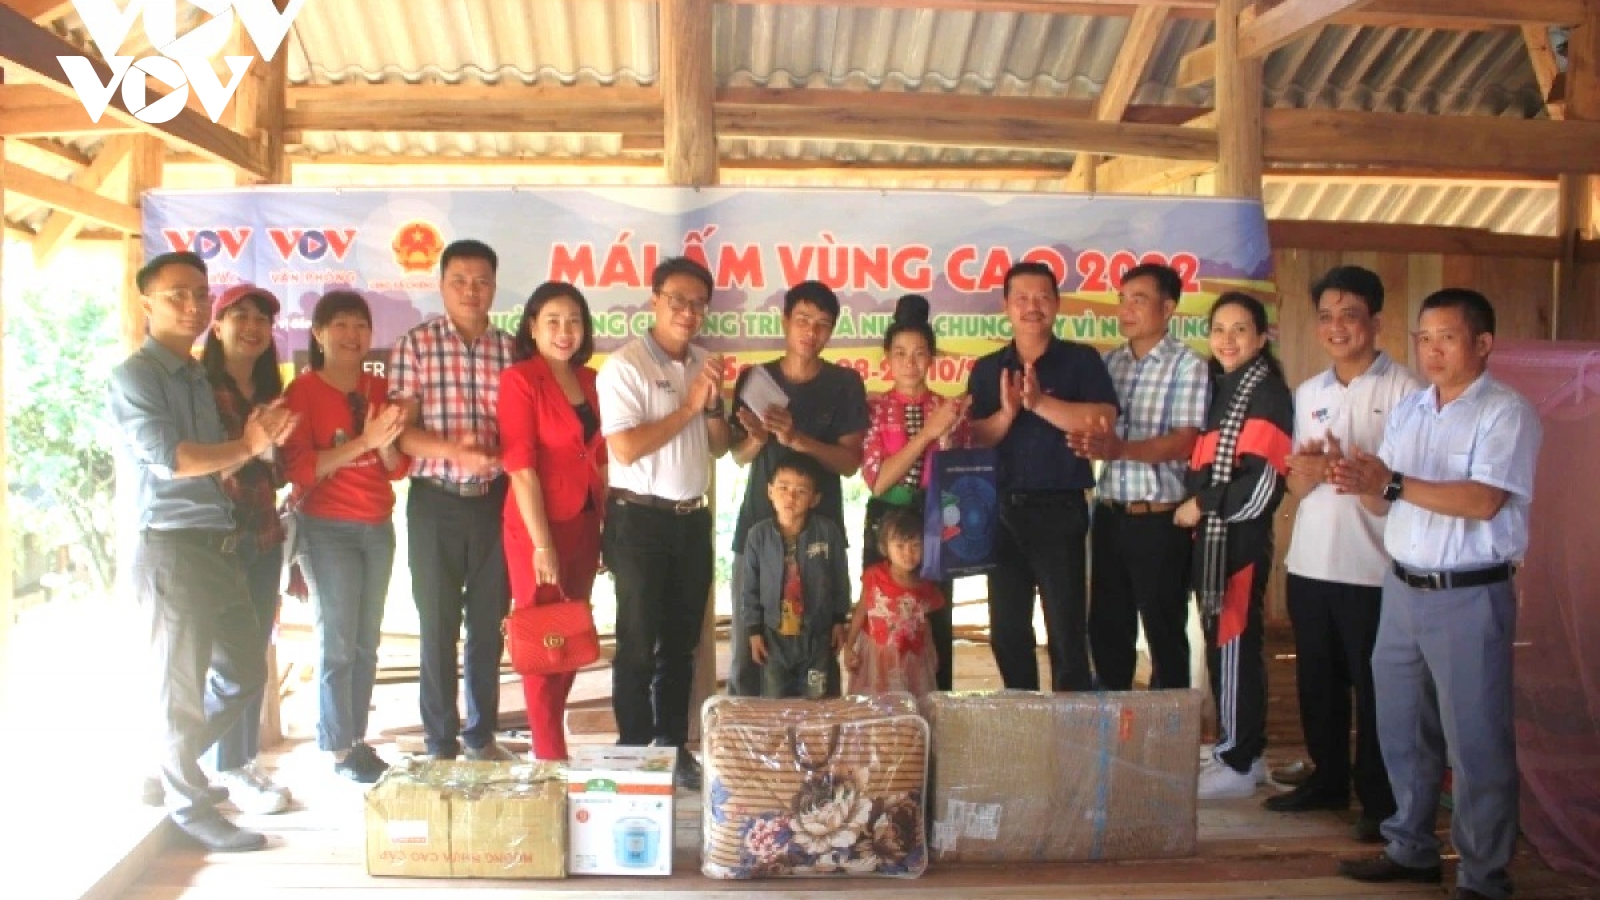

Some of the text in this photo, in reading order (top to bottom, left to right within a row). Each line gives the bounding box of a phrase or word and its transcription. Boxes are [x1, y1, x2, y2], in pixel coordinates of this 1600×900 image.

[163, 230, 251, 259] VOV
[267, 230, 356, 260] VOV
[549, 231, 657, 288] MÁI
[776, 233, 932, 290] VÙNG
[1074, 309, 1098, 338] VÌ
